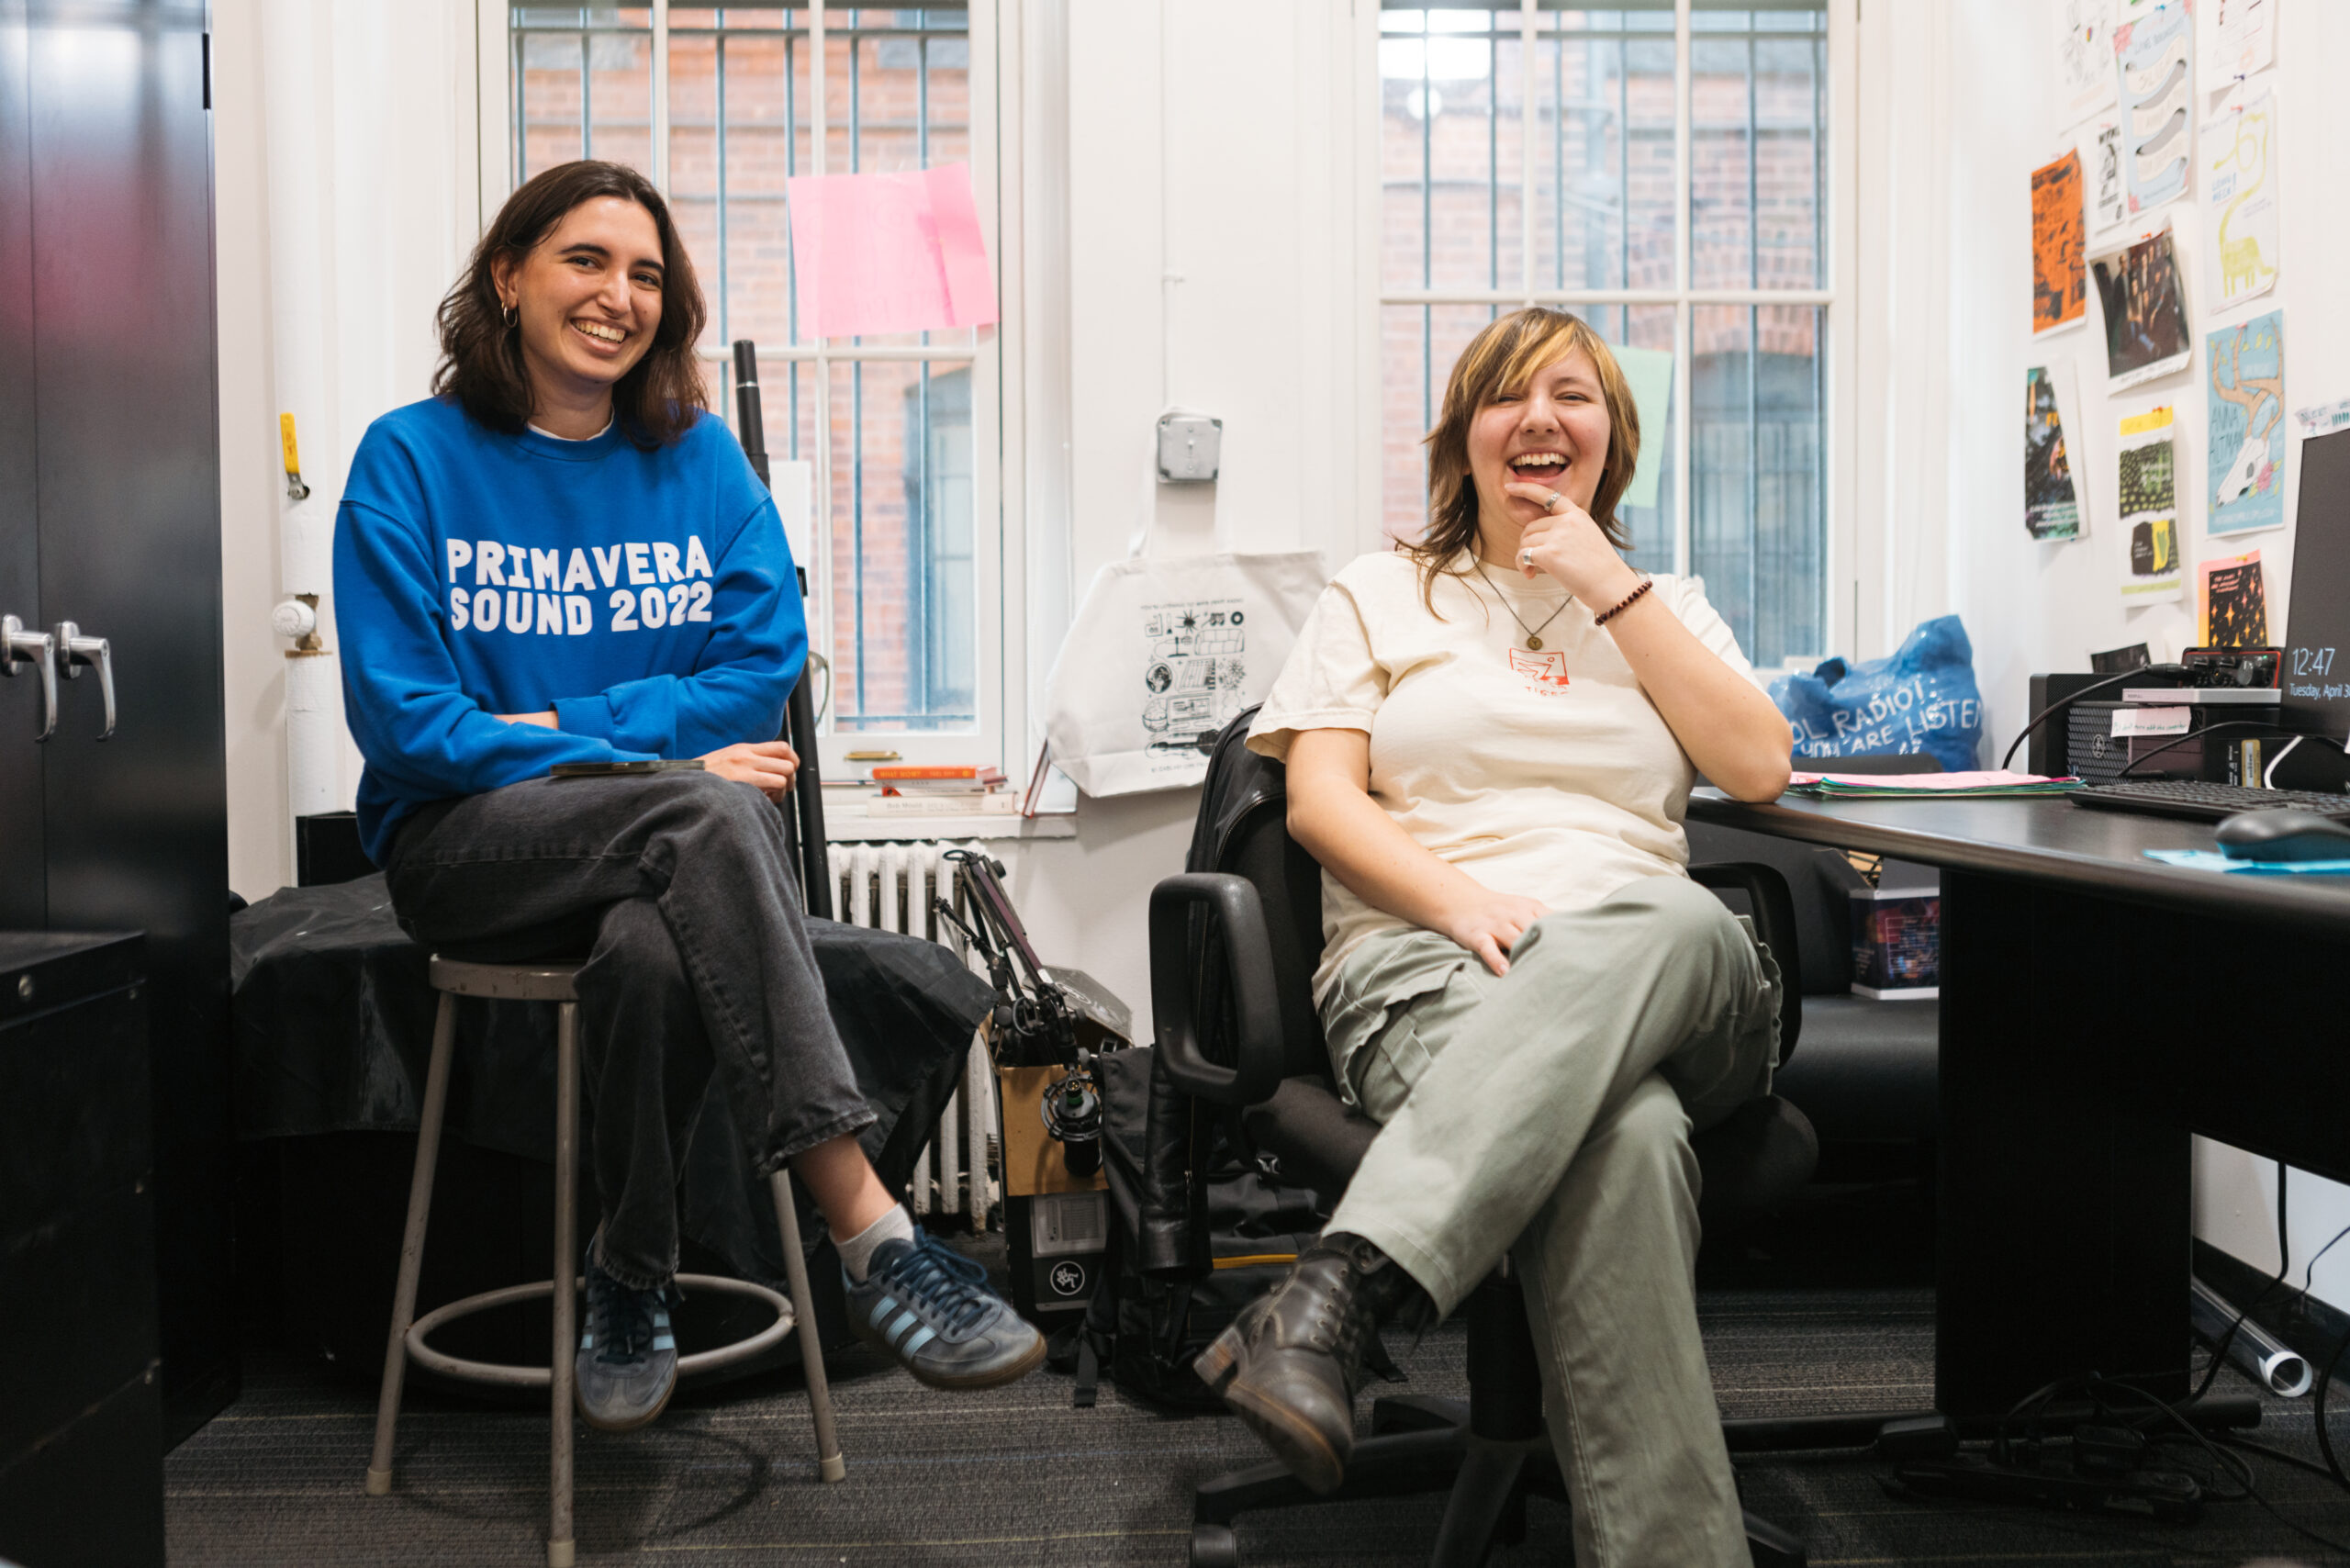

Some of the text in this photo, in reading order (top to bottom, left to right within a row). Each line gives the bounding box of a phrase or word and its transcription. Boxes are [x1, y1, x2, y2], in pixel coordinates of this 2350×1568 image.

[447, 535, 713, 592] PRIMAVERA
[450, 581, 713, 635] SOUND 2022
[2292, 647, 2335, 676] 12:47
[1832, 680, 1925, 739] RADIO!
[2289, 683, 2322, 700] Tuesday,
[2322, 683, 2343, 701] April
[1851, 725, 1895, 754] ARE
